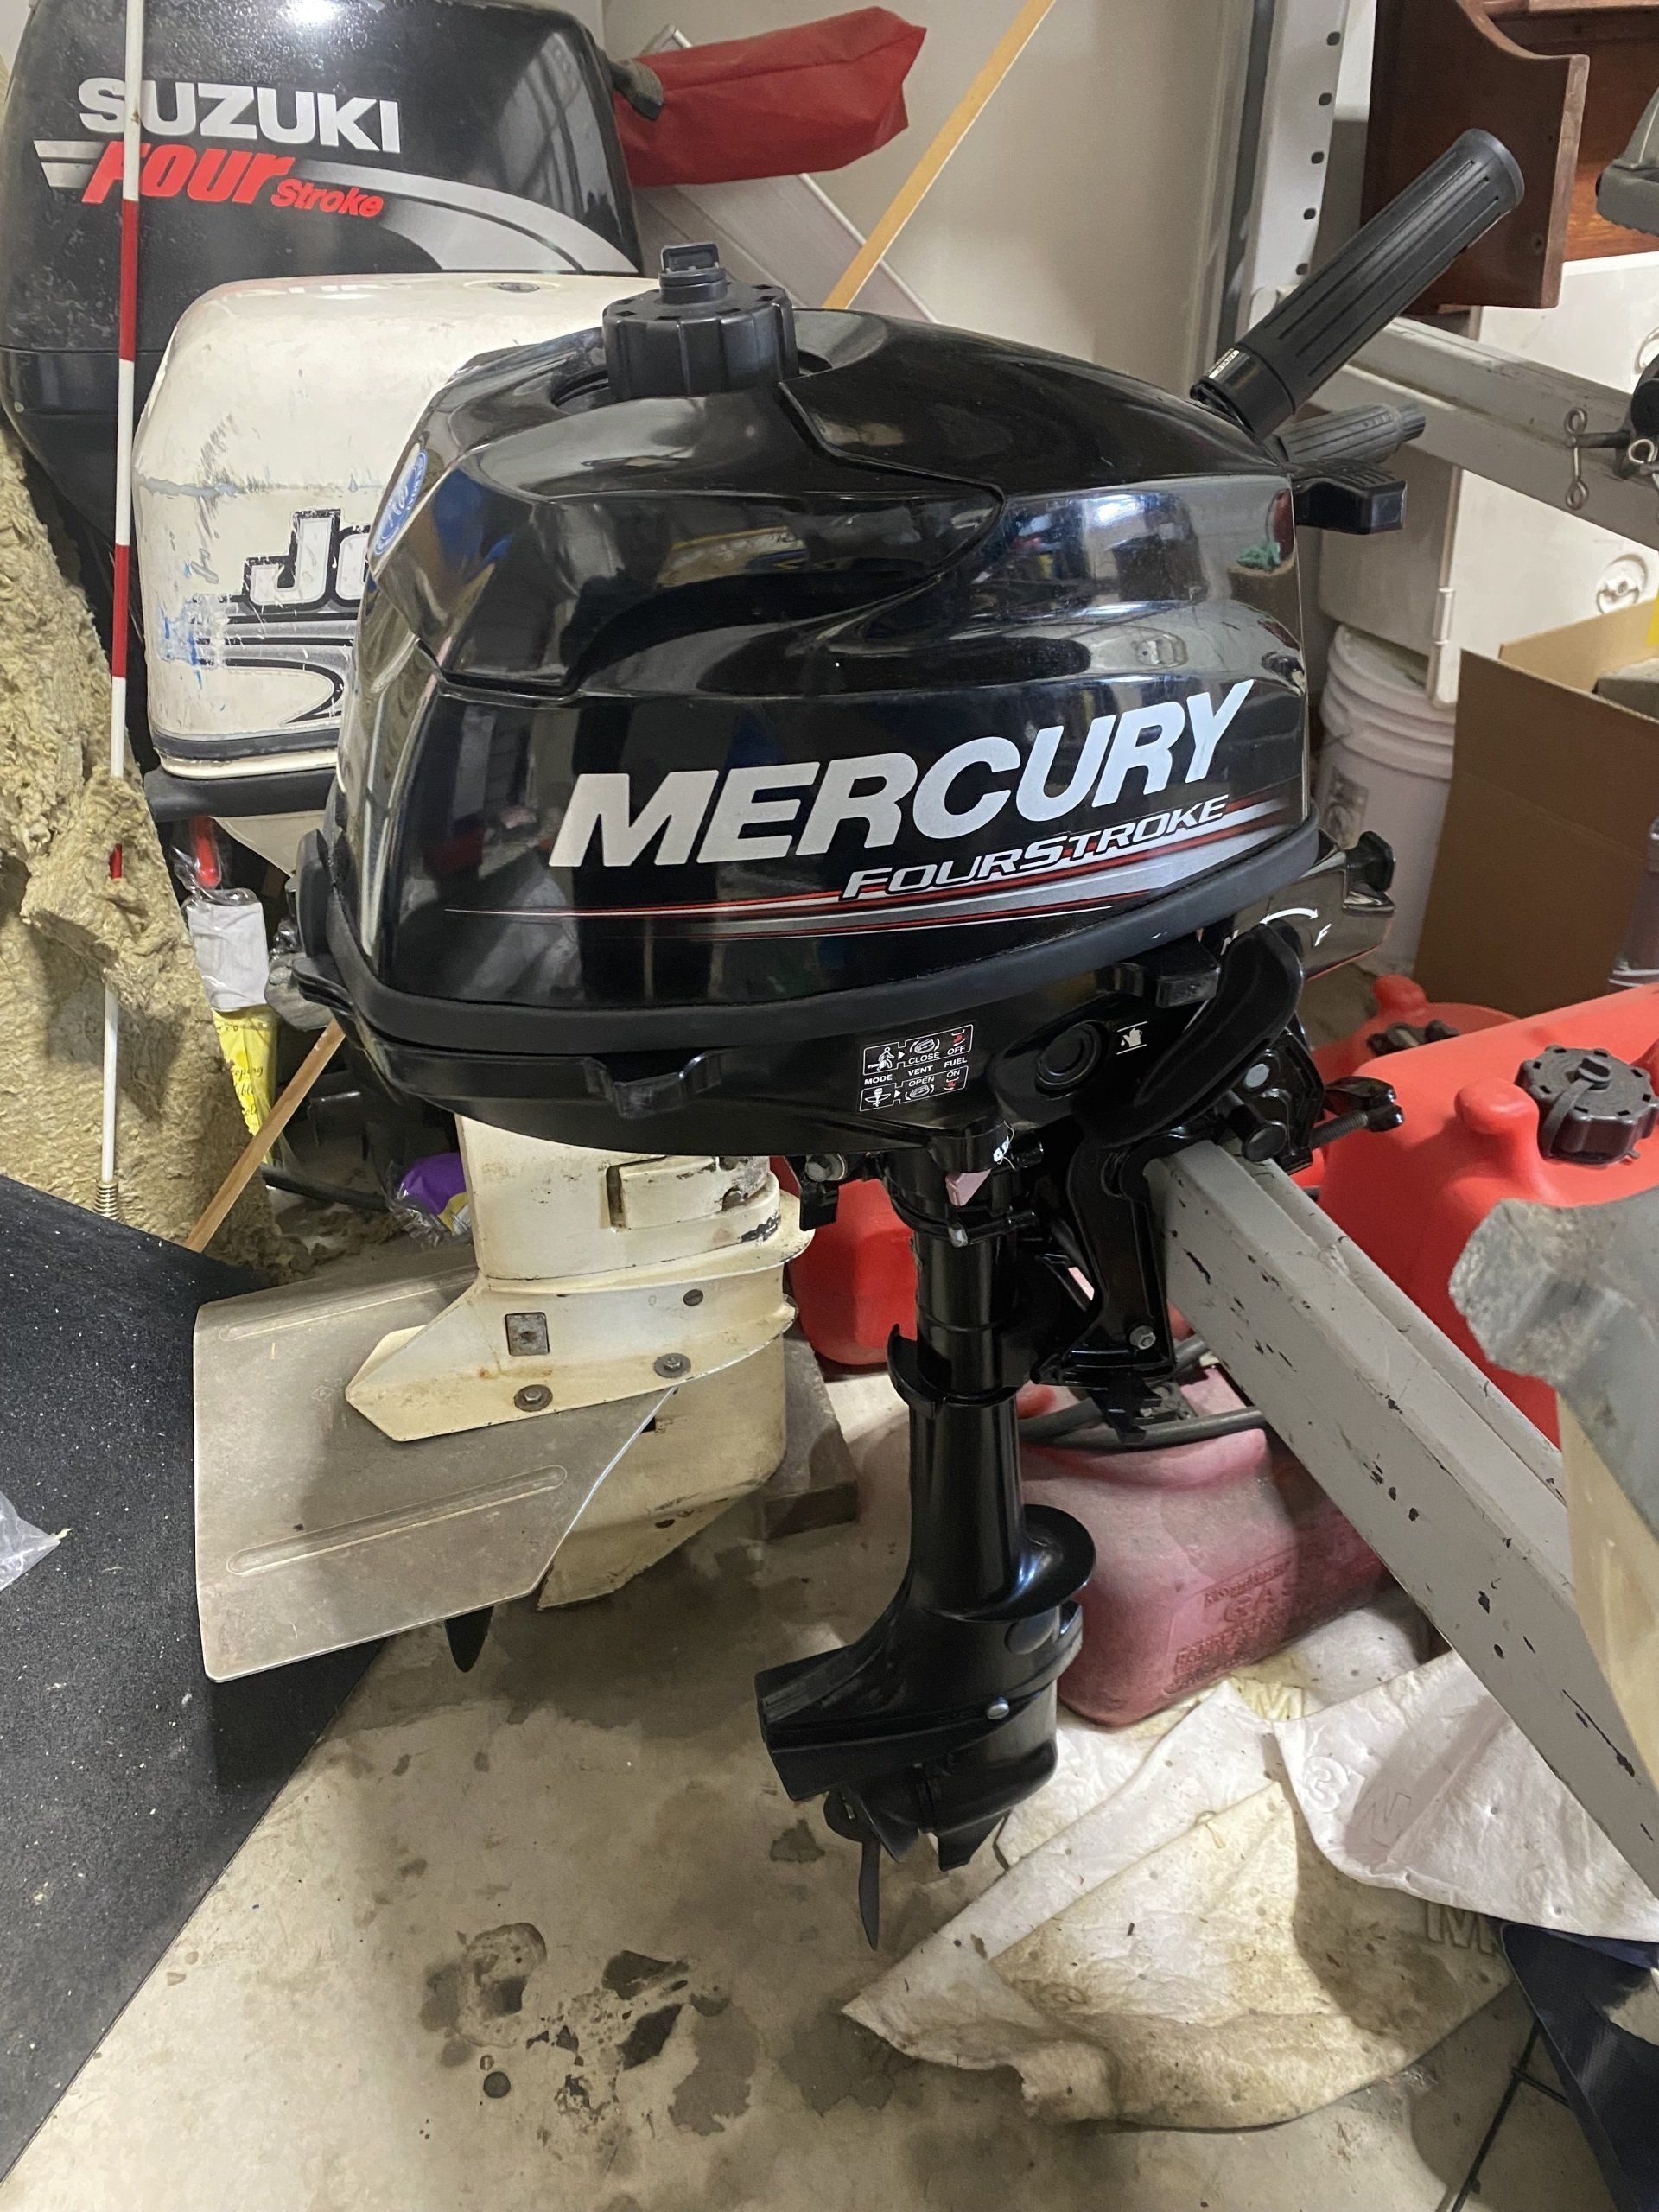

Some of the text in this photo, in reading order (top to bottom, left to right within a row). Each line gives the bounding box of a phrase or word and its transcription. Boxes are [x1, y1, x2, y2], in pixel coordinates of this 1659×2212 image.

[78, 77, 401, 154] SUZUKI
[270, 178, 385, 218] Stroke
[548, 679, 1254, 868] MERCURY
[841, 795, 1229, 901] FOURSTROKE
[1314, 923, 1332, 947] F
[864, 1057, 968, 1085] MODE VENT FUEL
[908, 1045, 966, 1065] CLOSE OFF
[908, 1070, 961, 1087] OPEN ON
